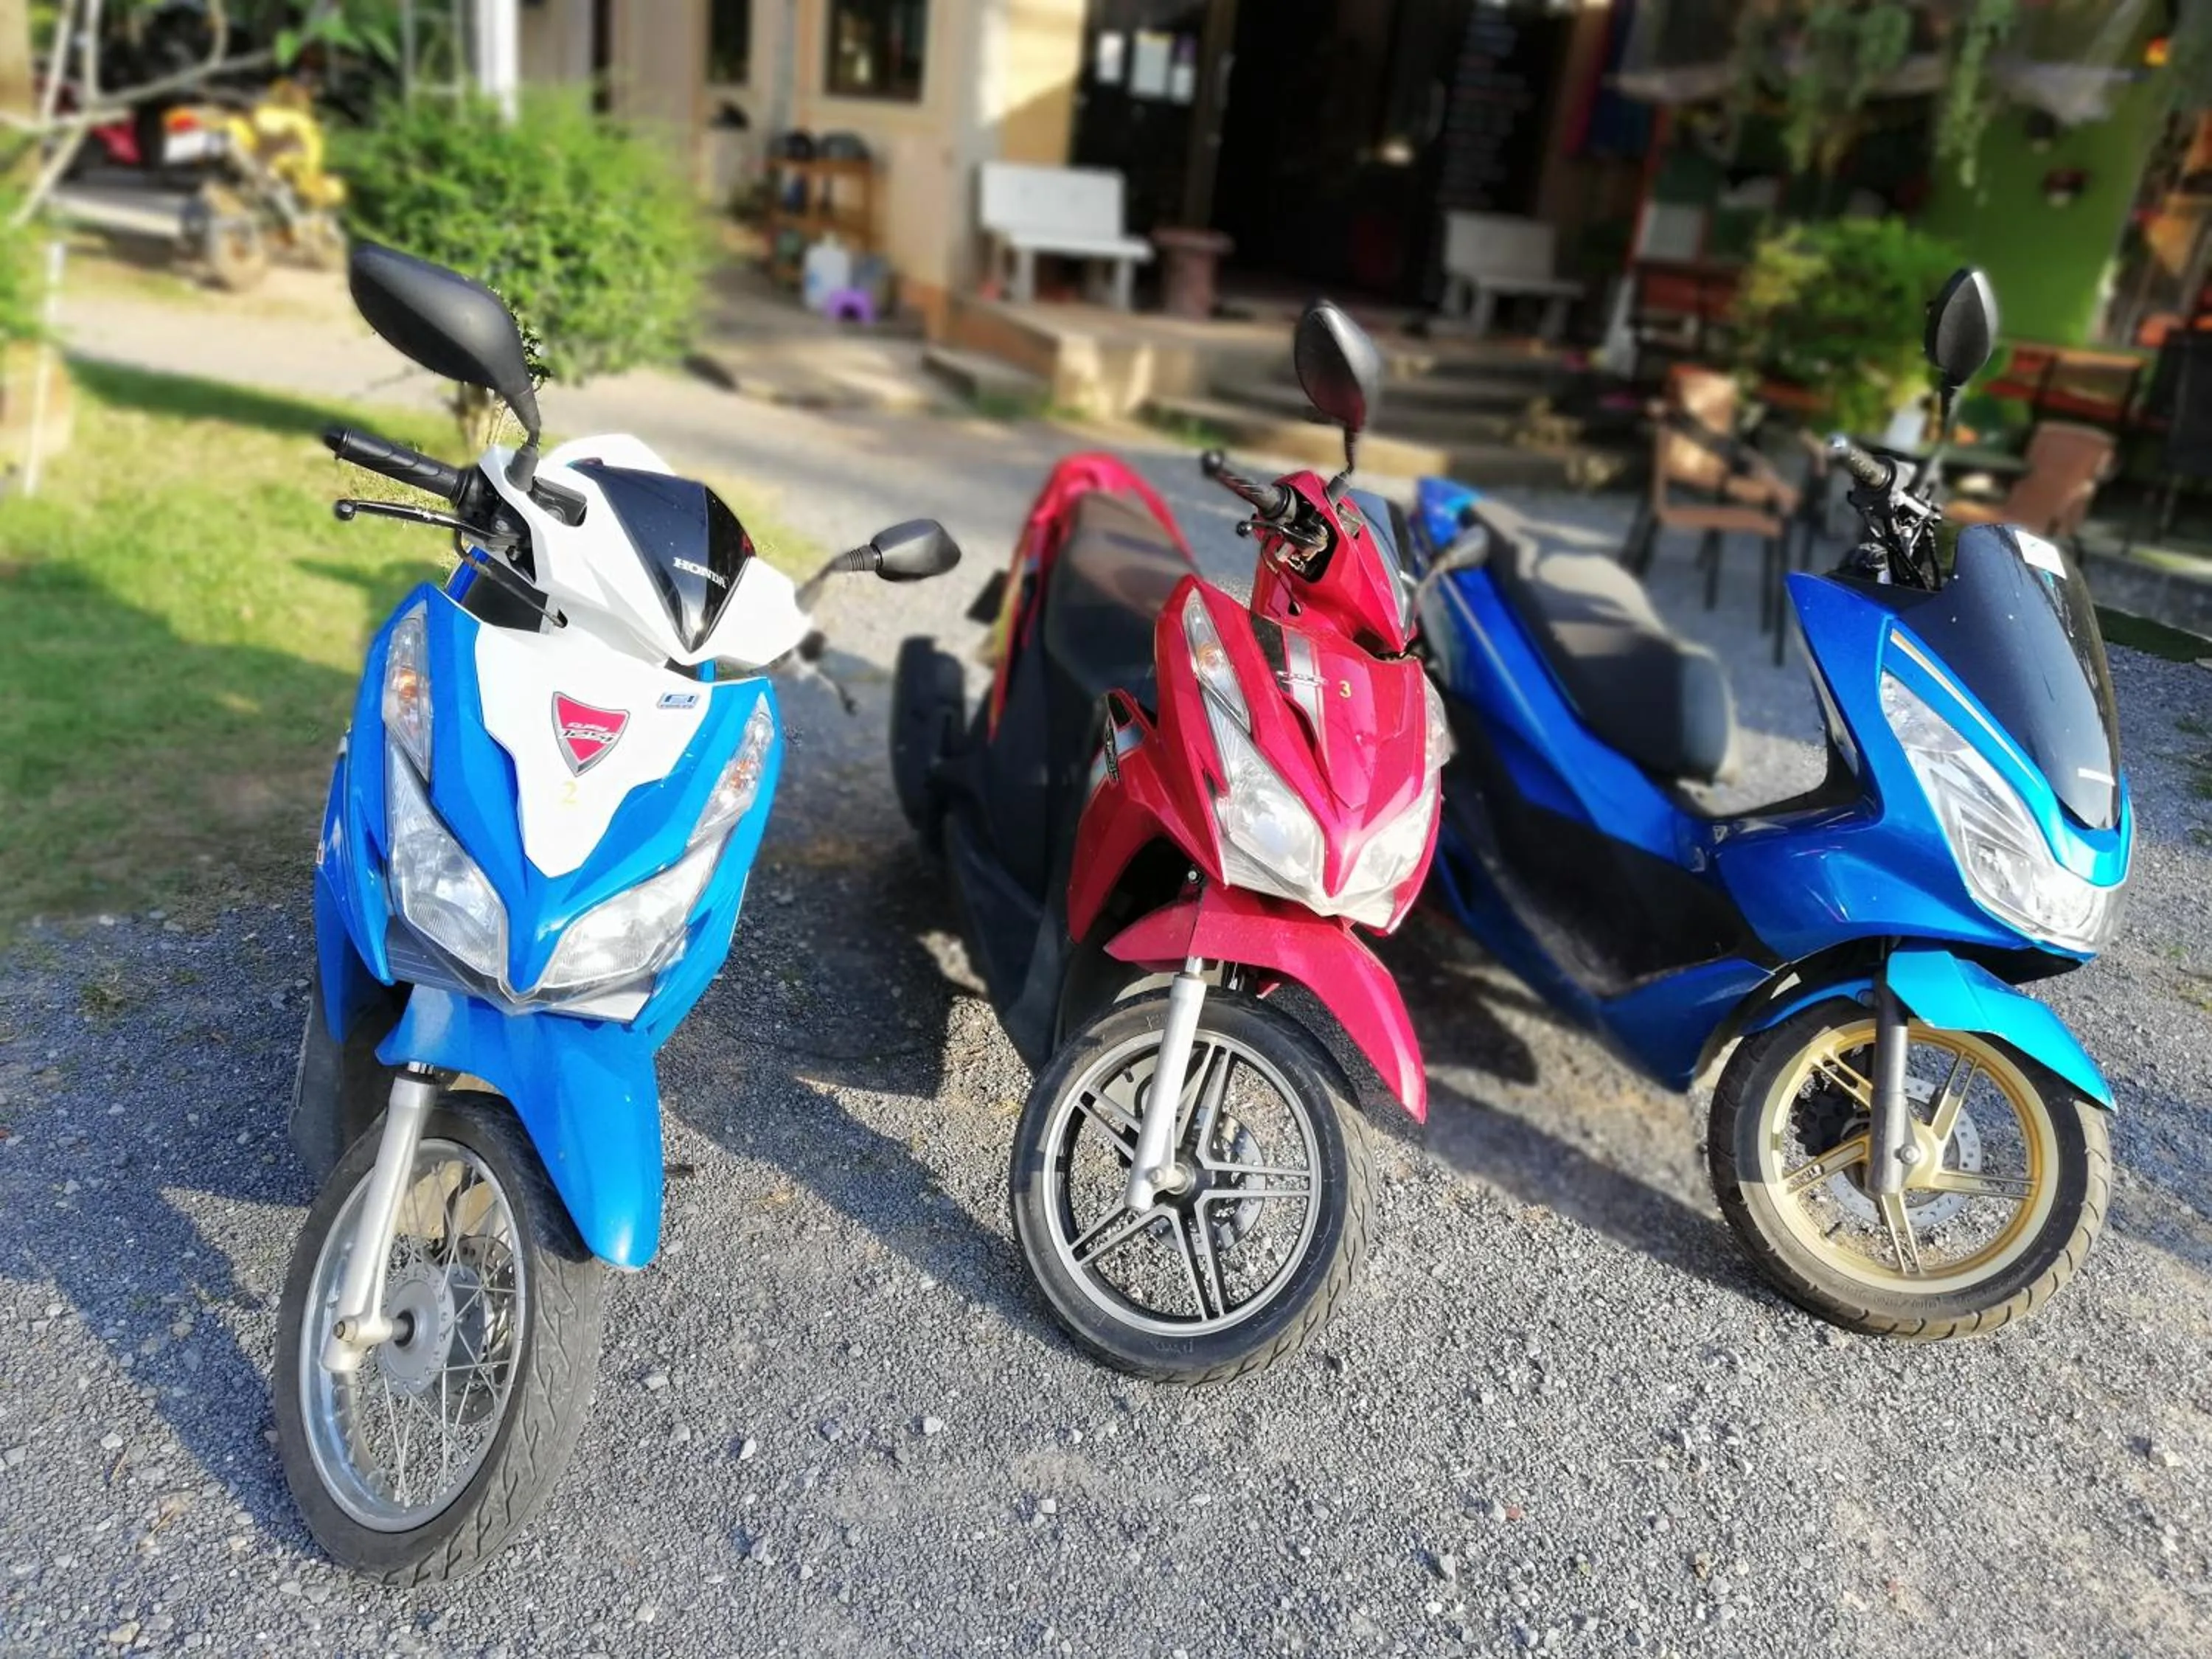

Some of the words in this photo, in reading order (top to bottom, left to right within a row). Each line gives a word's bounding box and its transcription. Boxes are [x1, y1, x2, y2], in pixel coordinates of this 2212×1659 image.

[672, 557, 726, 589] HONDA
[1339, 680, 1352, 698] 3
[560, 781, 577, 804] 2
